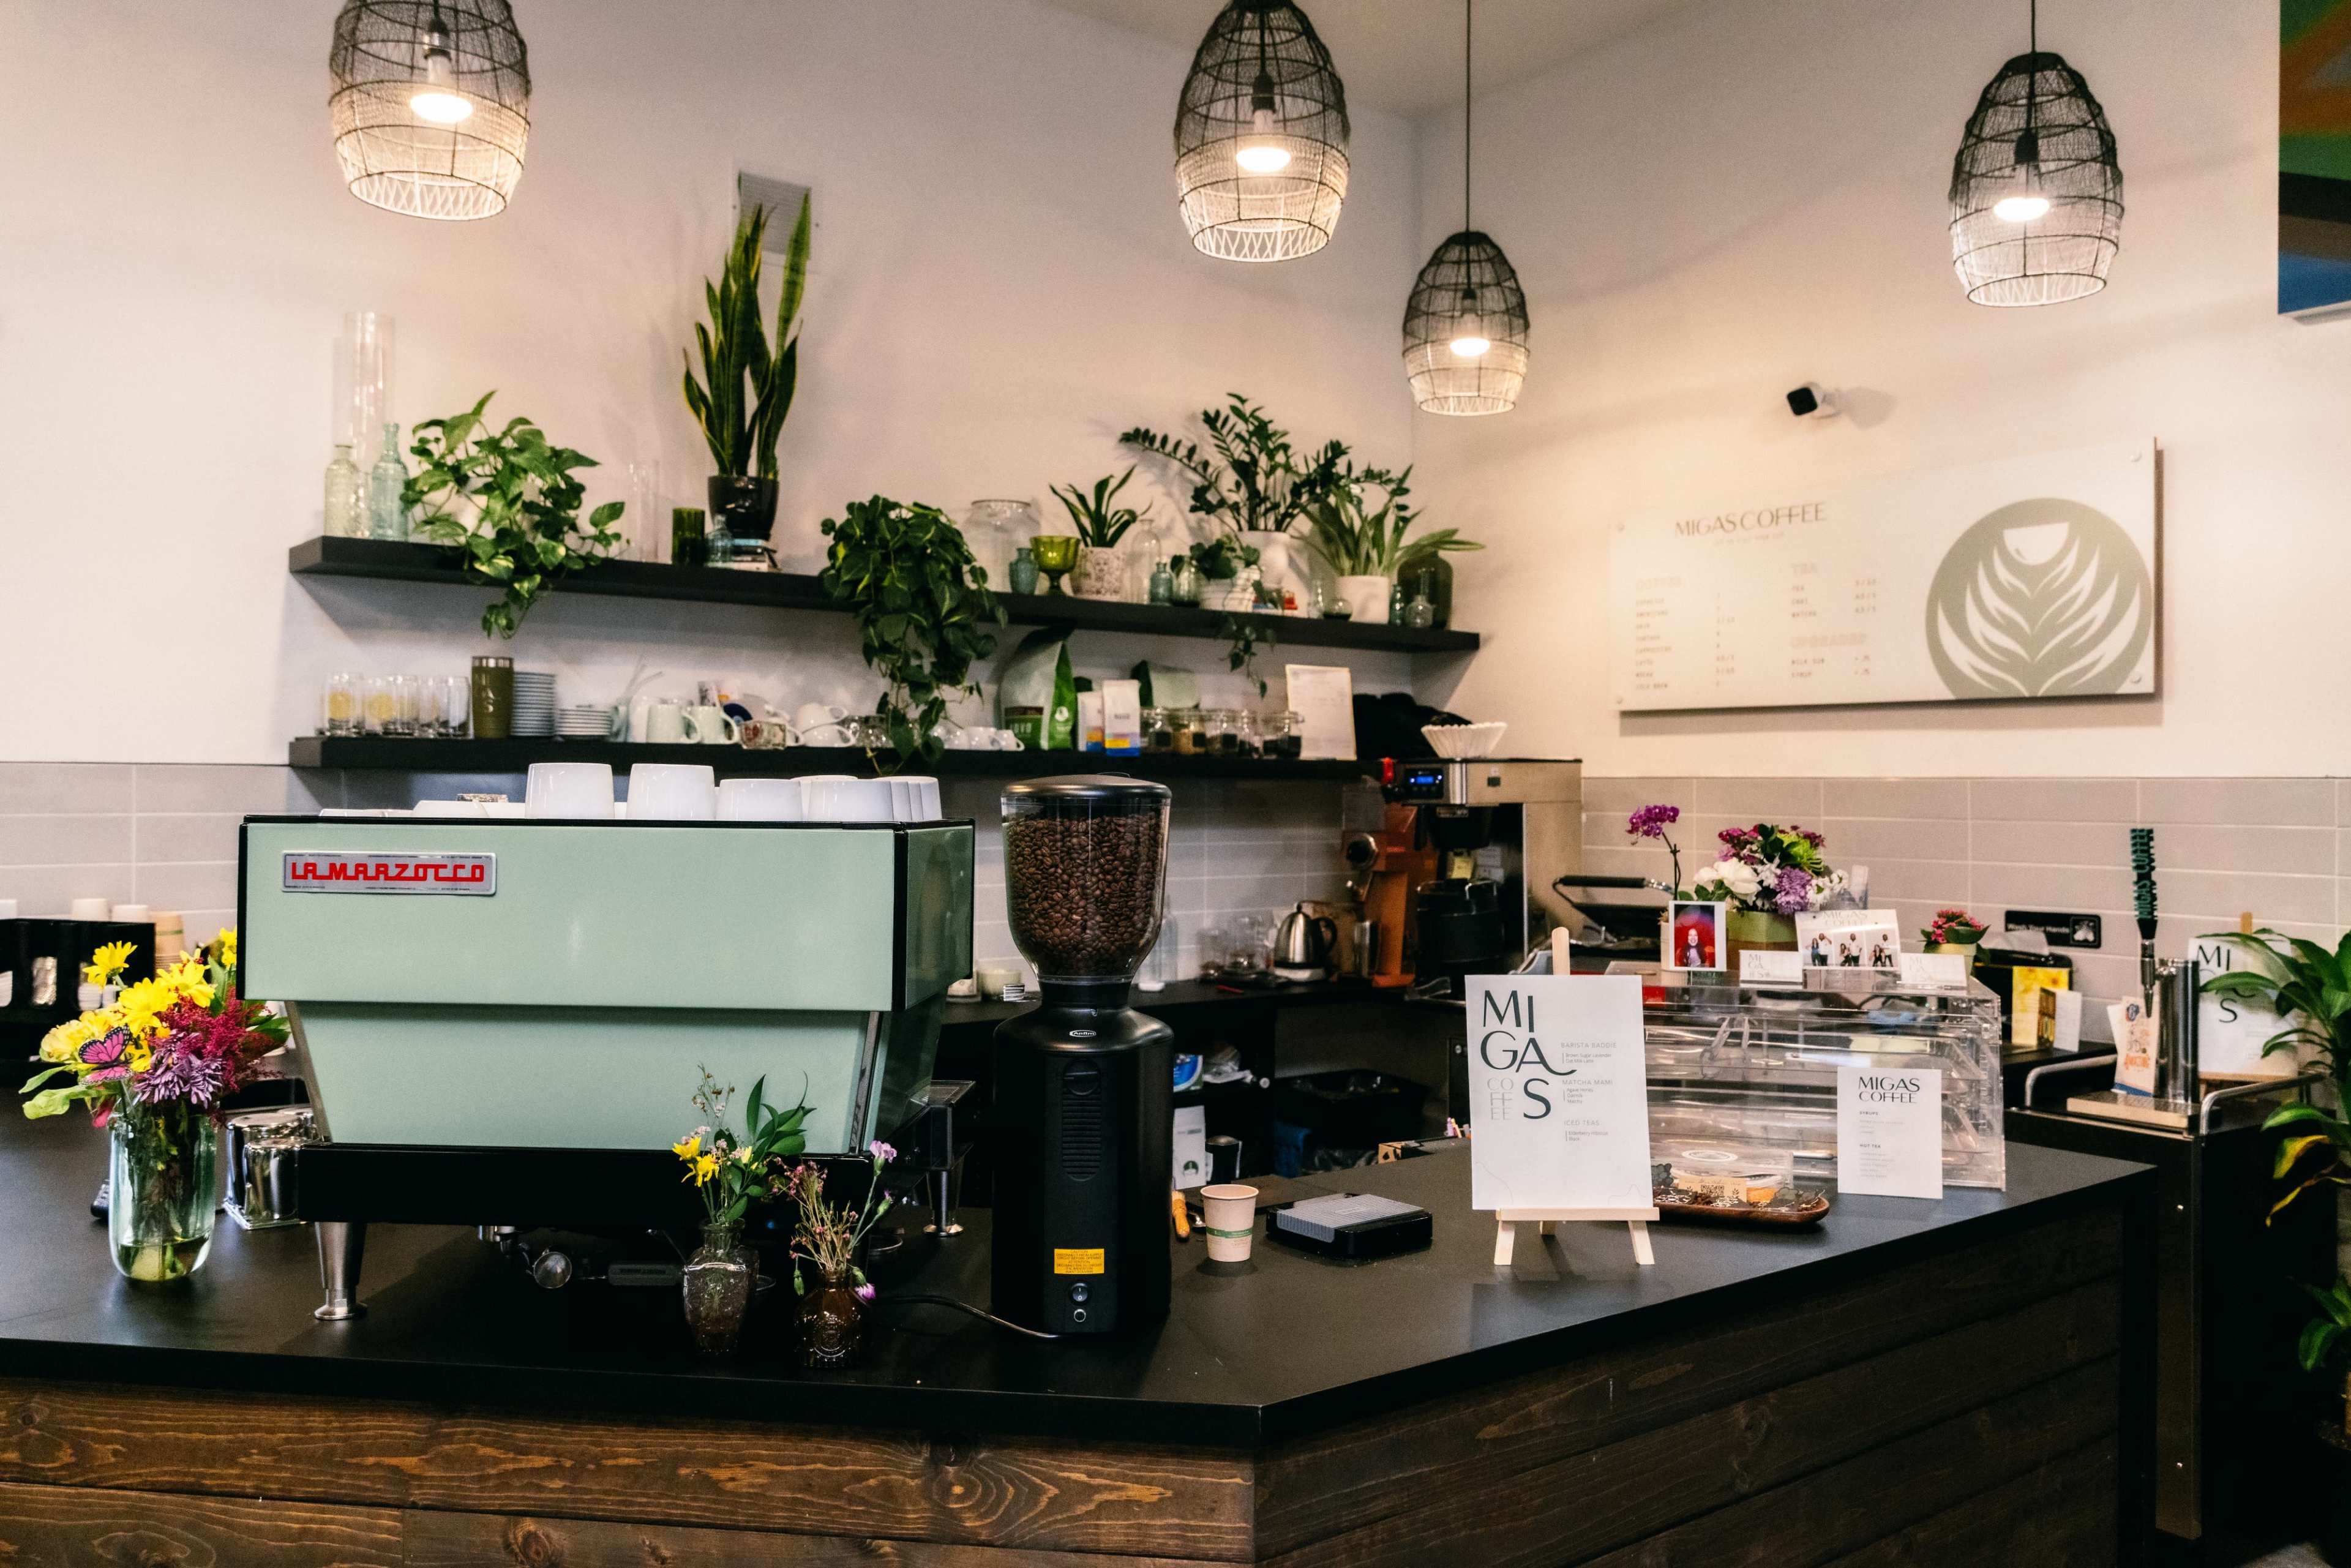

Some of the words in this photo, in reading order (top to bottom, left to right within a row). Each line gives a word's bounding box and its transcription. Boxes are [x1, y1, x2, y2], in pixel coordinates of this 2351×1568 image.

[1674, 513, 1736, 536] MIGAS
[1740, 502, 1827, 531] COFFEE
[1858, 1076, 1920, 1092] MIGAS
[1859, 1091, 1917, 1103] COFFEE
